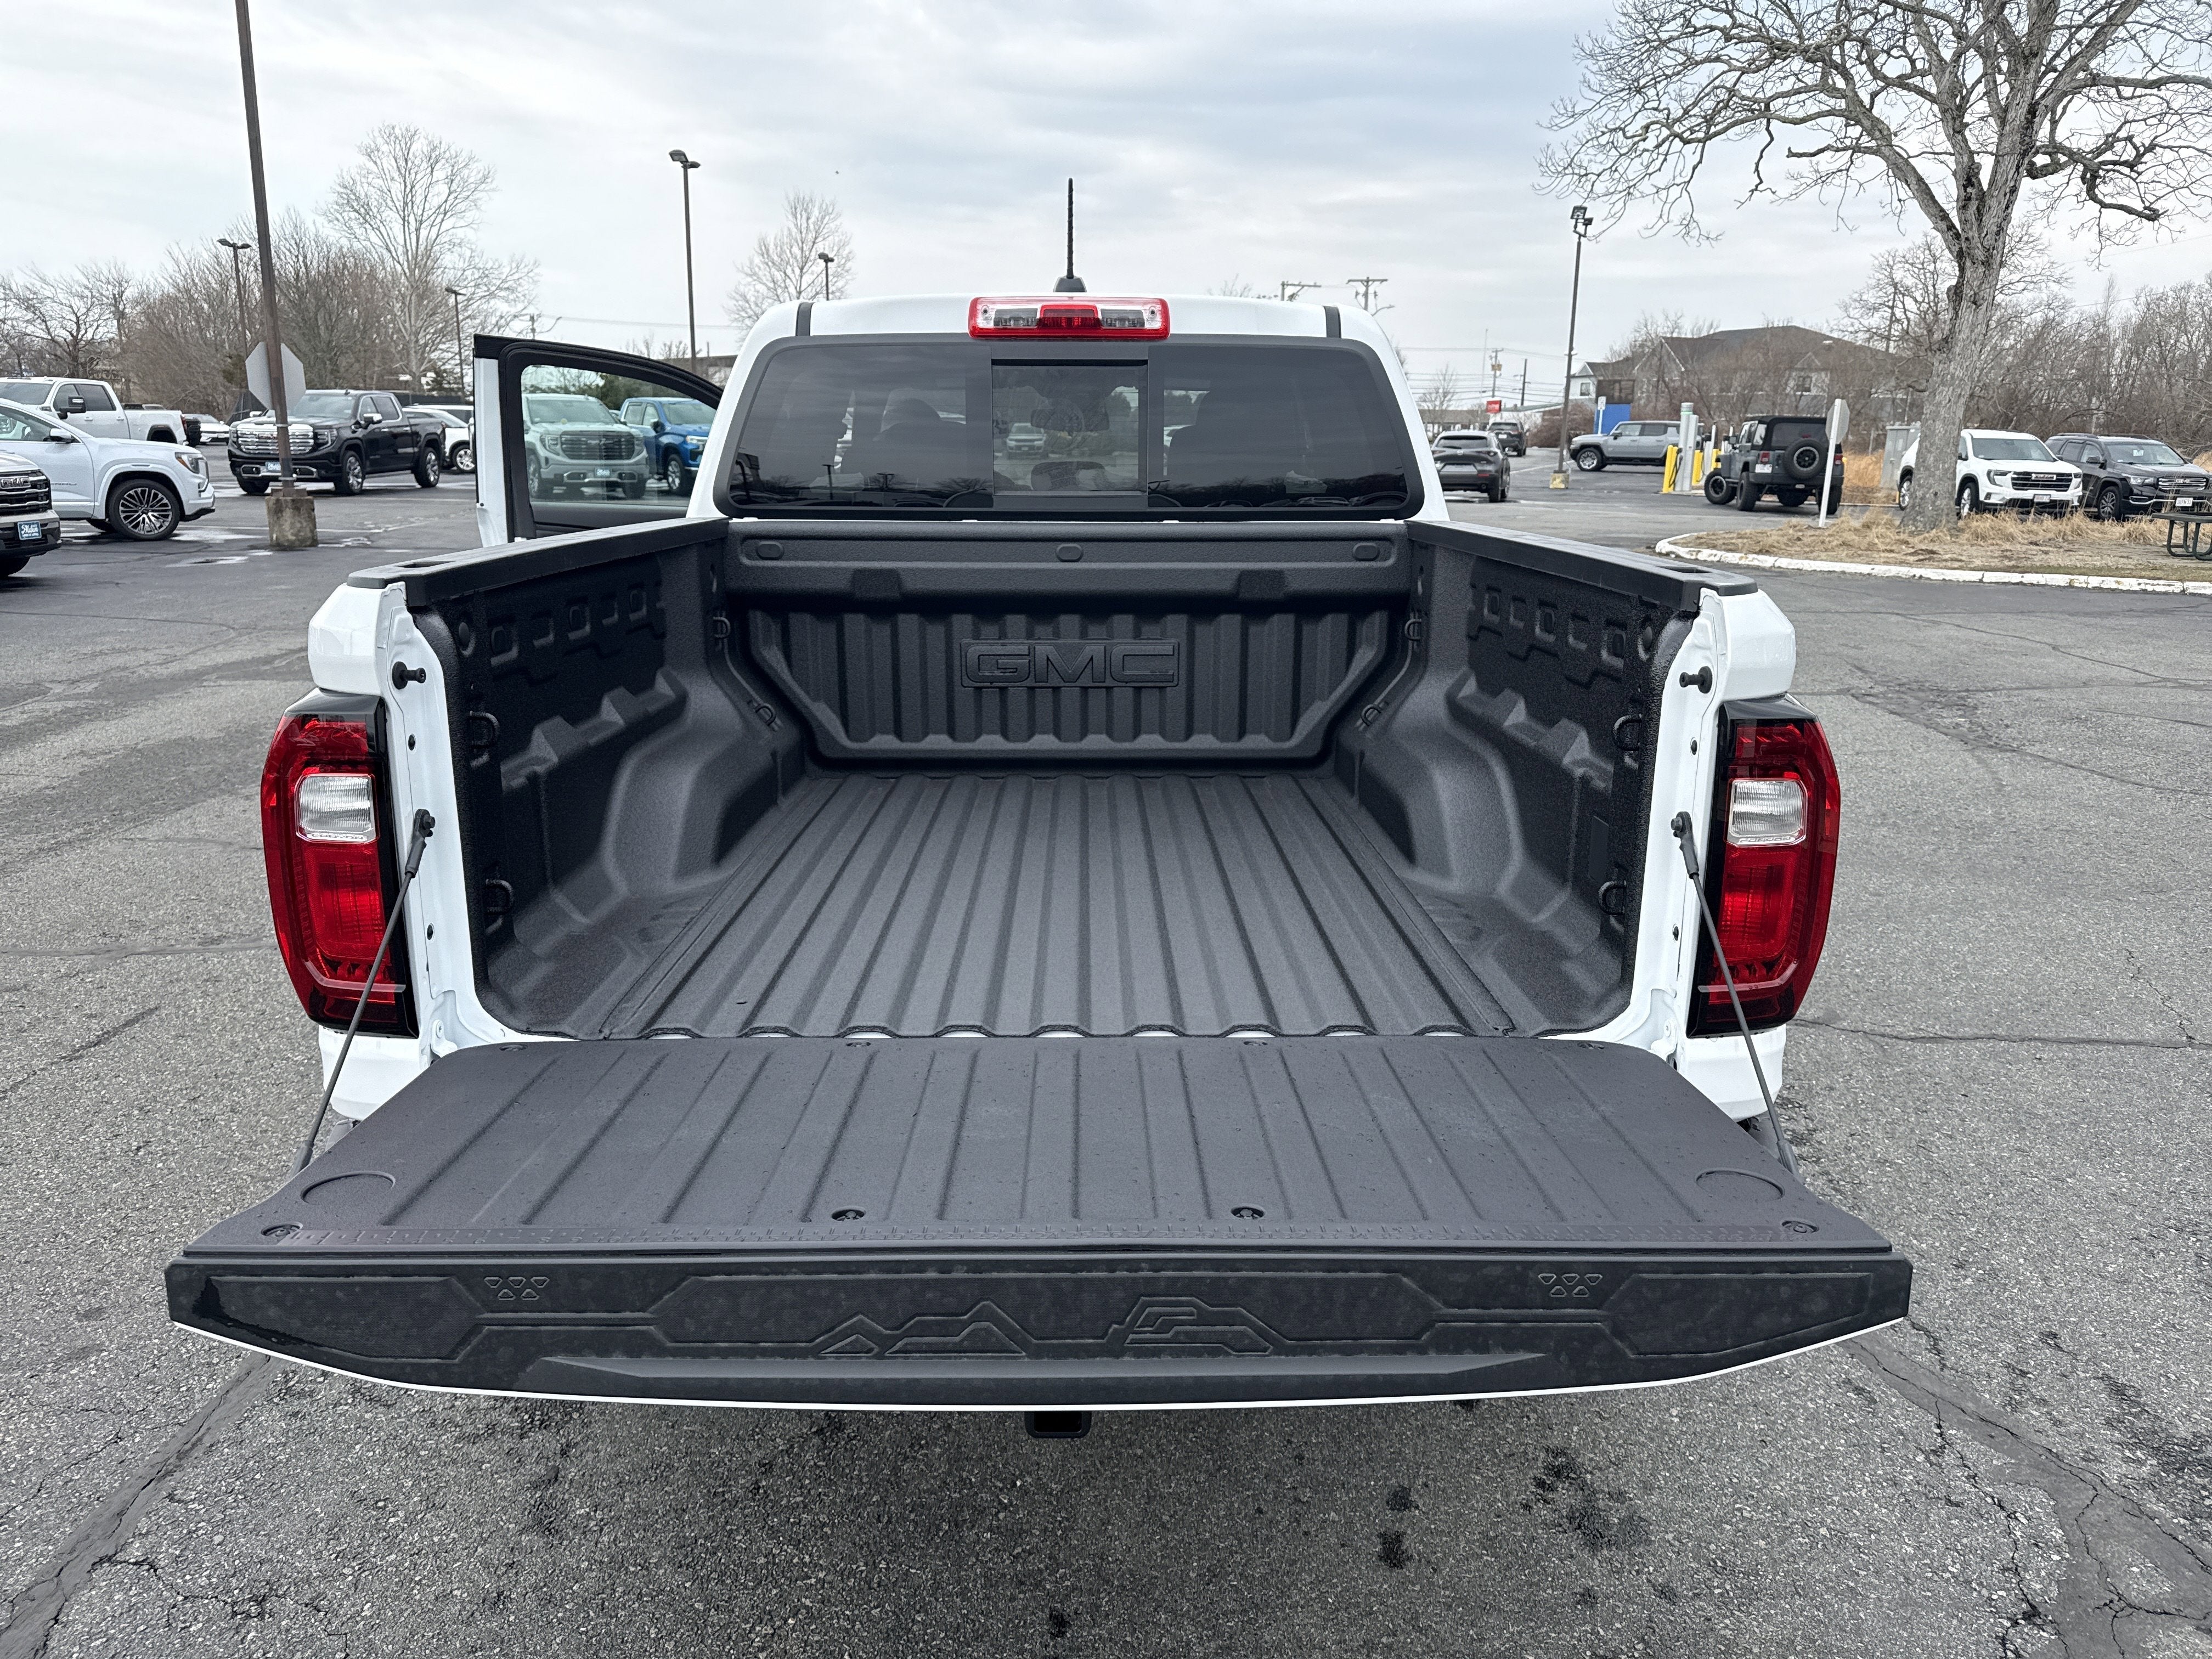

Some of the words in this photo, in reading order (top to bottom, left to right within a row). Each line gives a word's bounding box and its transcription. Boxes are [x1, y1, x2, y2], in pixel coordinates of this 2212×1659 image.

[1, 477, 31, 488] GMC
[21, 524, 39, 534] Alden
[966, 644, 1175, 683] GMC
